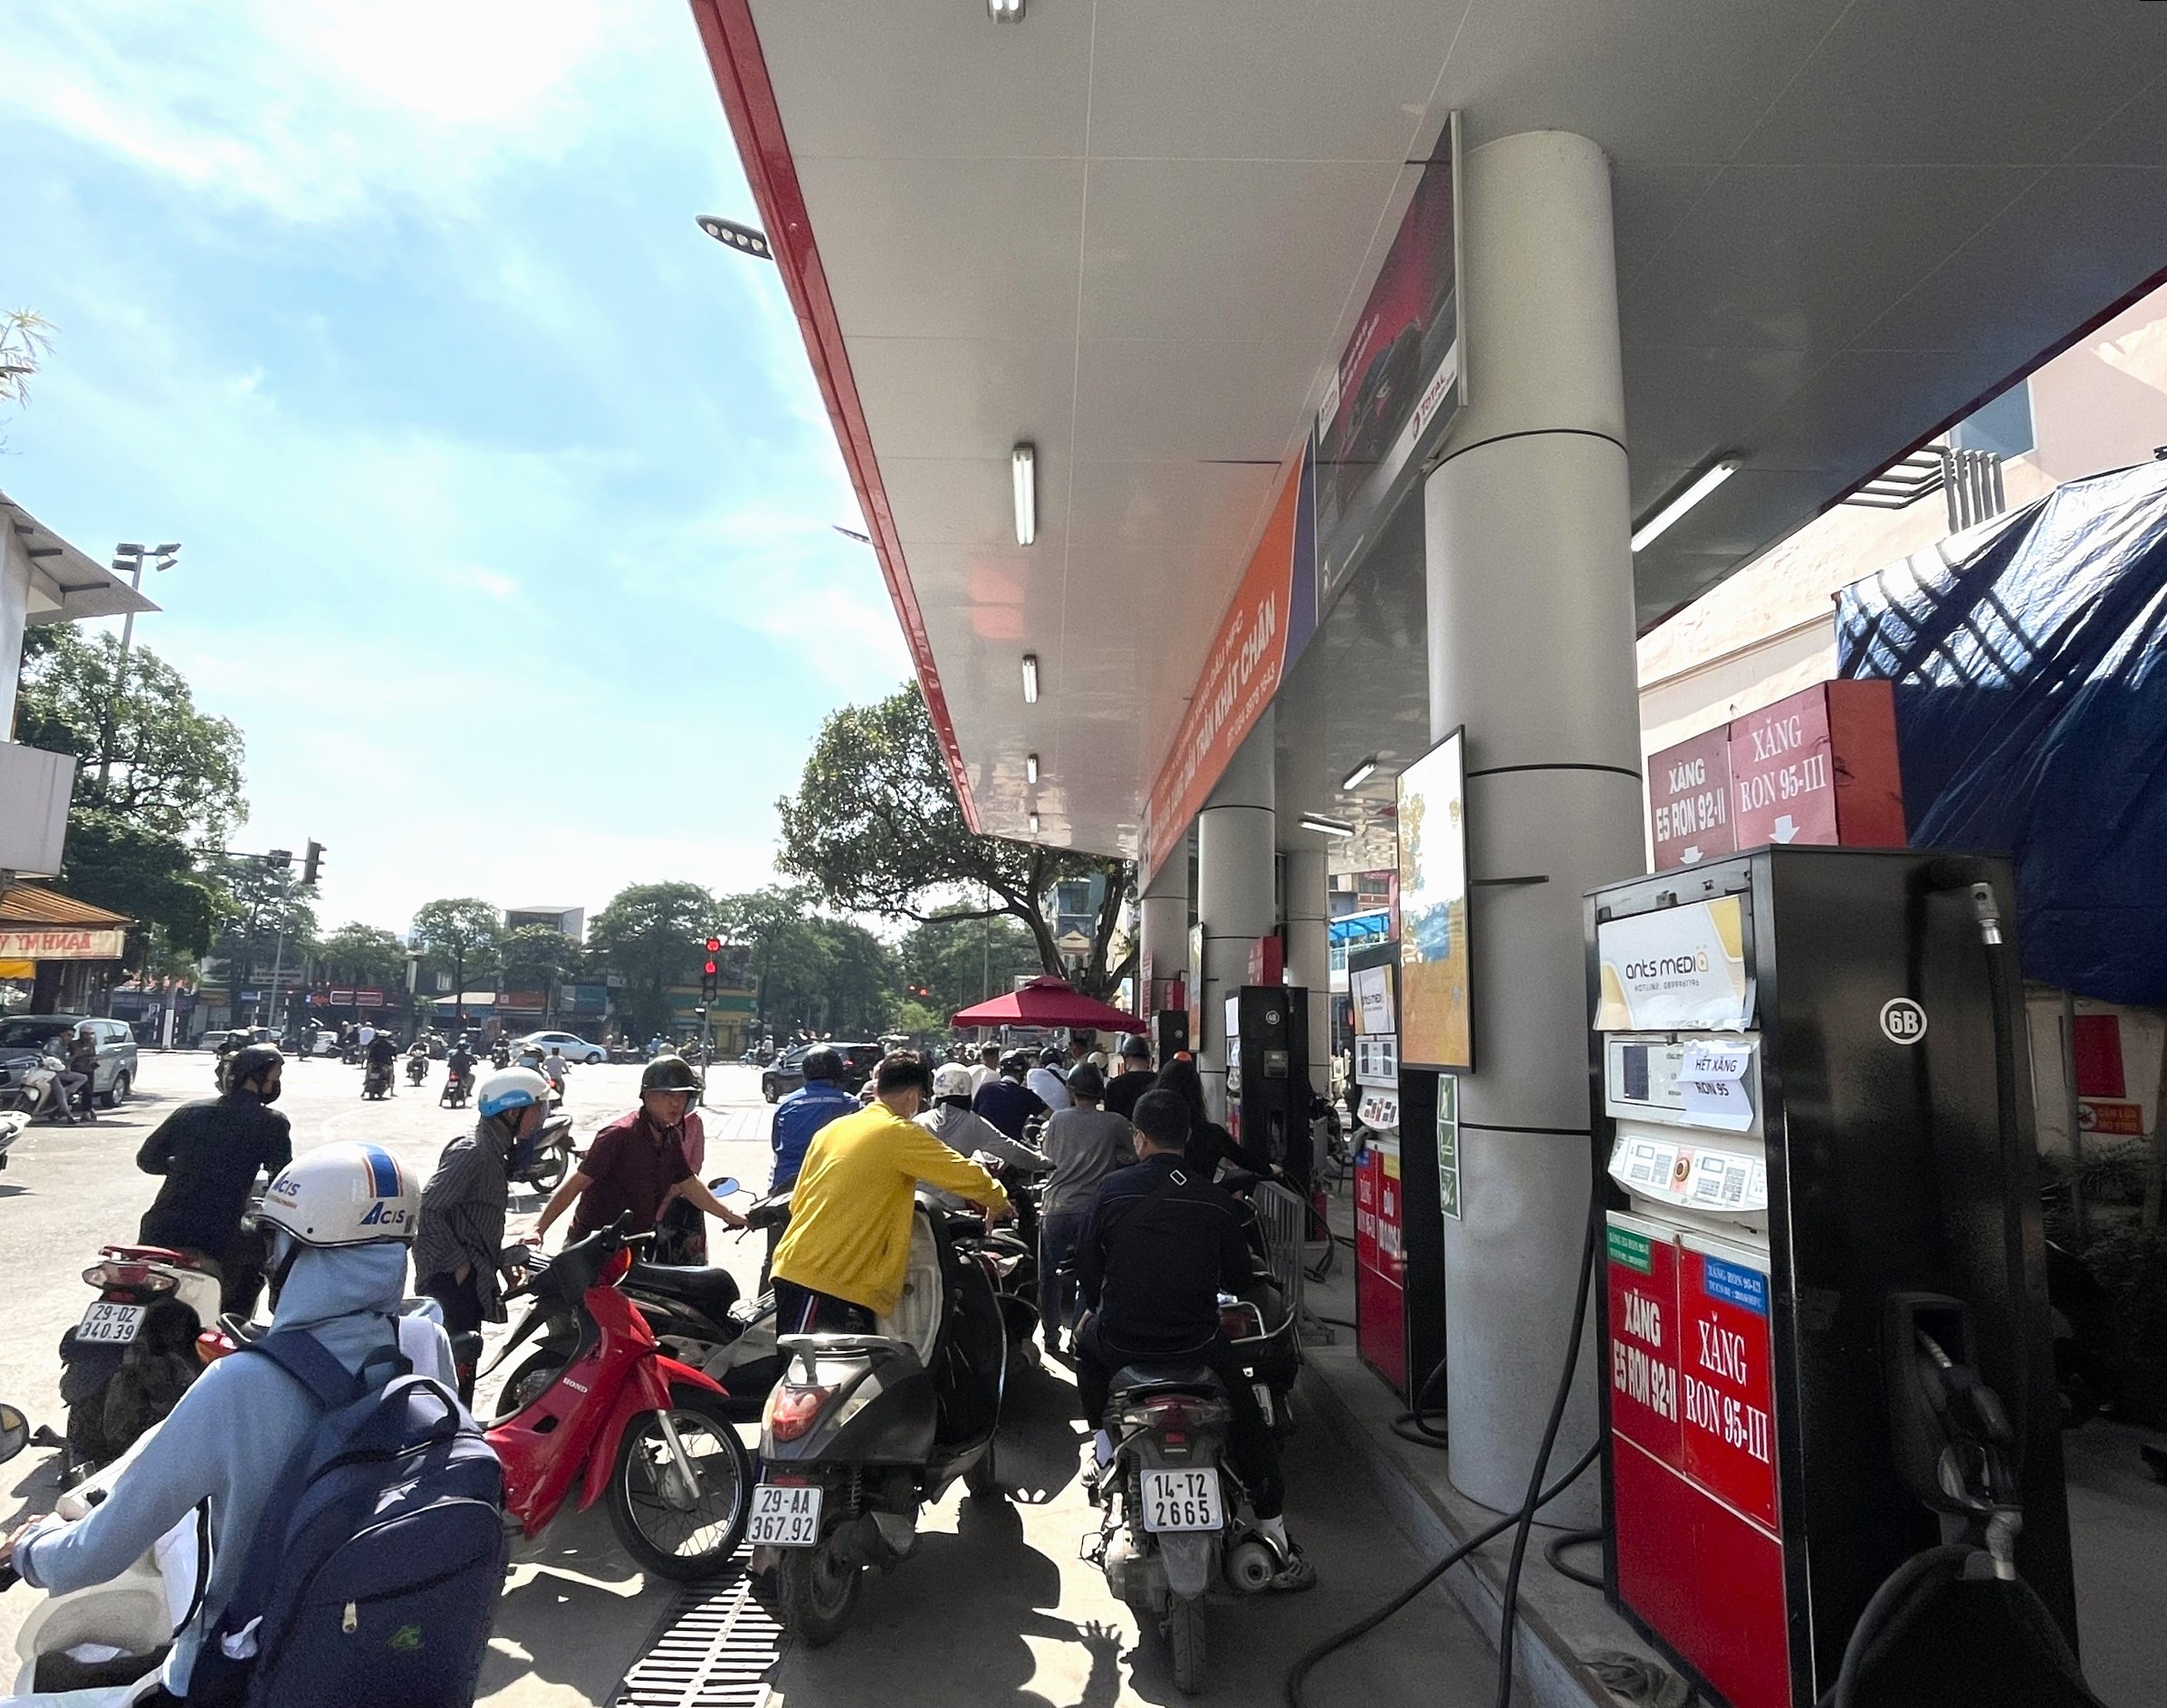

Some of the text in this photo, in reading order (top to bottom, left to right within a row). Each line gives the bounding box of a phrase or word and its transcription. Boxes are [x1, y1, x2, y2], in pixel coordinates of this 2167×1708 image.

[1421, 374, 1446, 417] TOTAL
[1215, 658, 1240, 733] KHÁT
[1241, 590, 1275, 686] CHÂN
[1752, 715, 1803, 763] XĂNG
[1669, 758, 1706, 795] XĂNG
[1740, 753, 1827, 812] RON 95-III
[1656, 788, 1726, 842] E5 RON 92-II
[1625, 958, 1657, 980] ants
[1889, 1011, 1919, 1033] 6B
[1695, 1055, 1712, 1071] HẾT
[1712, 1057, 1738, 1072] XĂNG
[1695, 1082, 1716, 1095] RON
[1716, 1083, 1730, 1097] 95
[80, 1322, 134, 1340] 340.39
[1625, 1288, 1661, 1348] XĂNG
[1698, 1310, 1747, 1387] XĂNG
[1614, 1339, 1677, 1423] E5 RON 92-II
[1684, 1374, 1769, 1464] RON 95-III
[762, 1490, 810, 1514] 29-AA
[1155, 1473, 1207, 1499] 14-T2
[752, 1516, 813, 1541] 367.92
[1155, 1500, 1210, 1527] 2665
